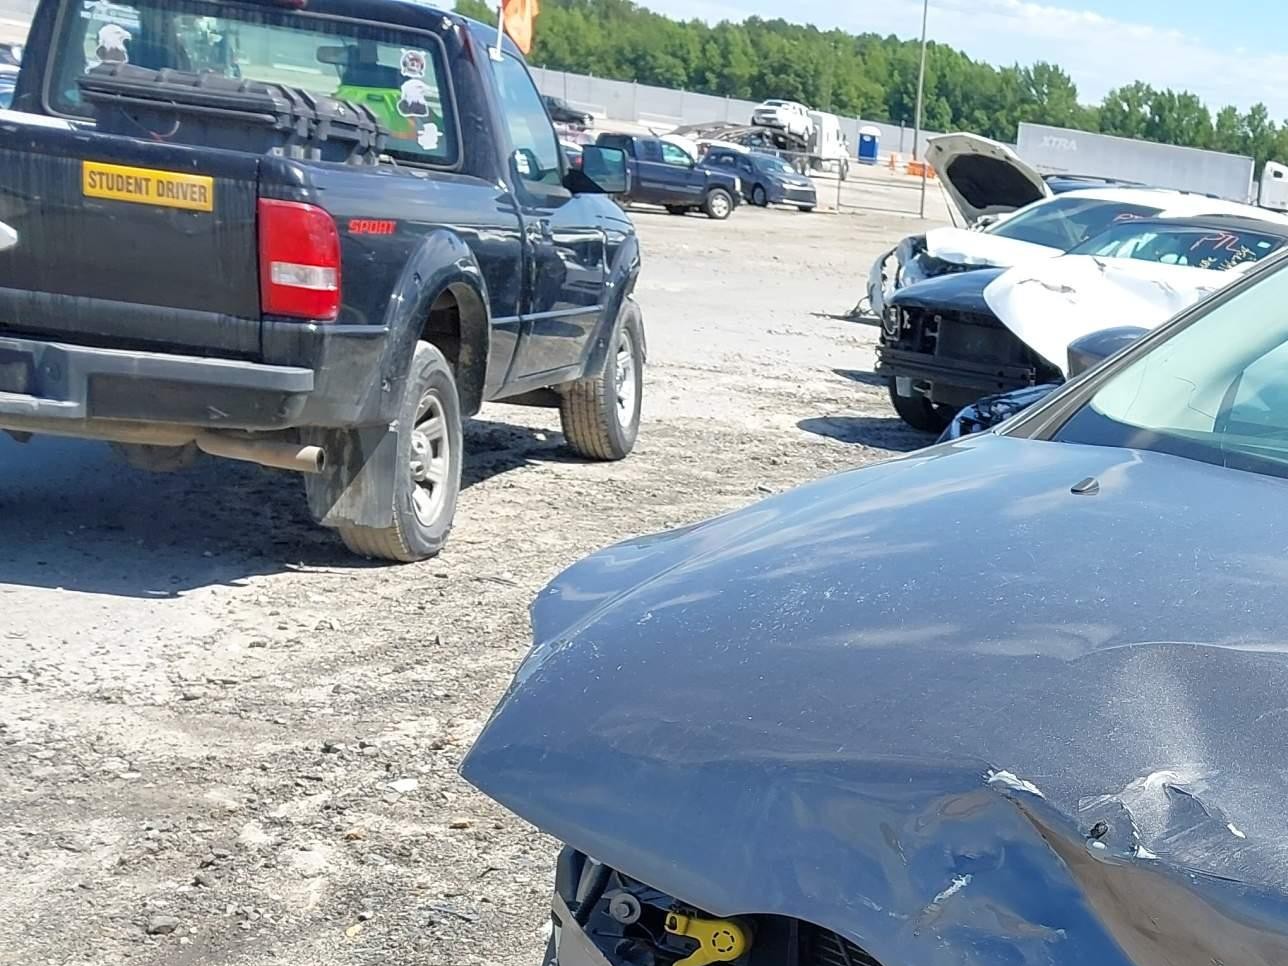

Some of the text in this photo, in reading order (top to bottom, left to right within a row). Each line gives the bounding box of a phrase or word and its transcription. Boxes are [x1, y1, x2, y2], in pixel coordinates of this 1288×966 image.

[1039, 135, 1077, 151] XTRA
[88, 170, 208, 203] STUDENT DRIVER
[348, 219, 396, 234] SPORT
